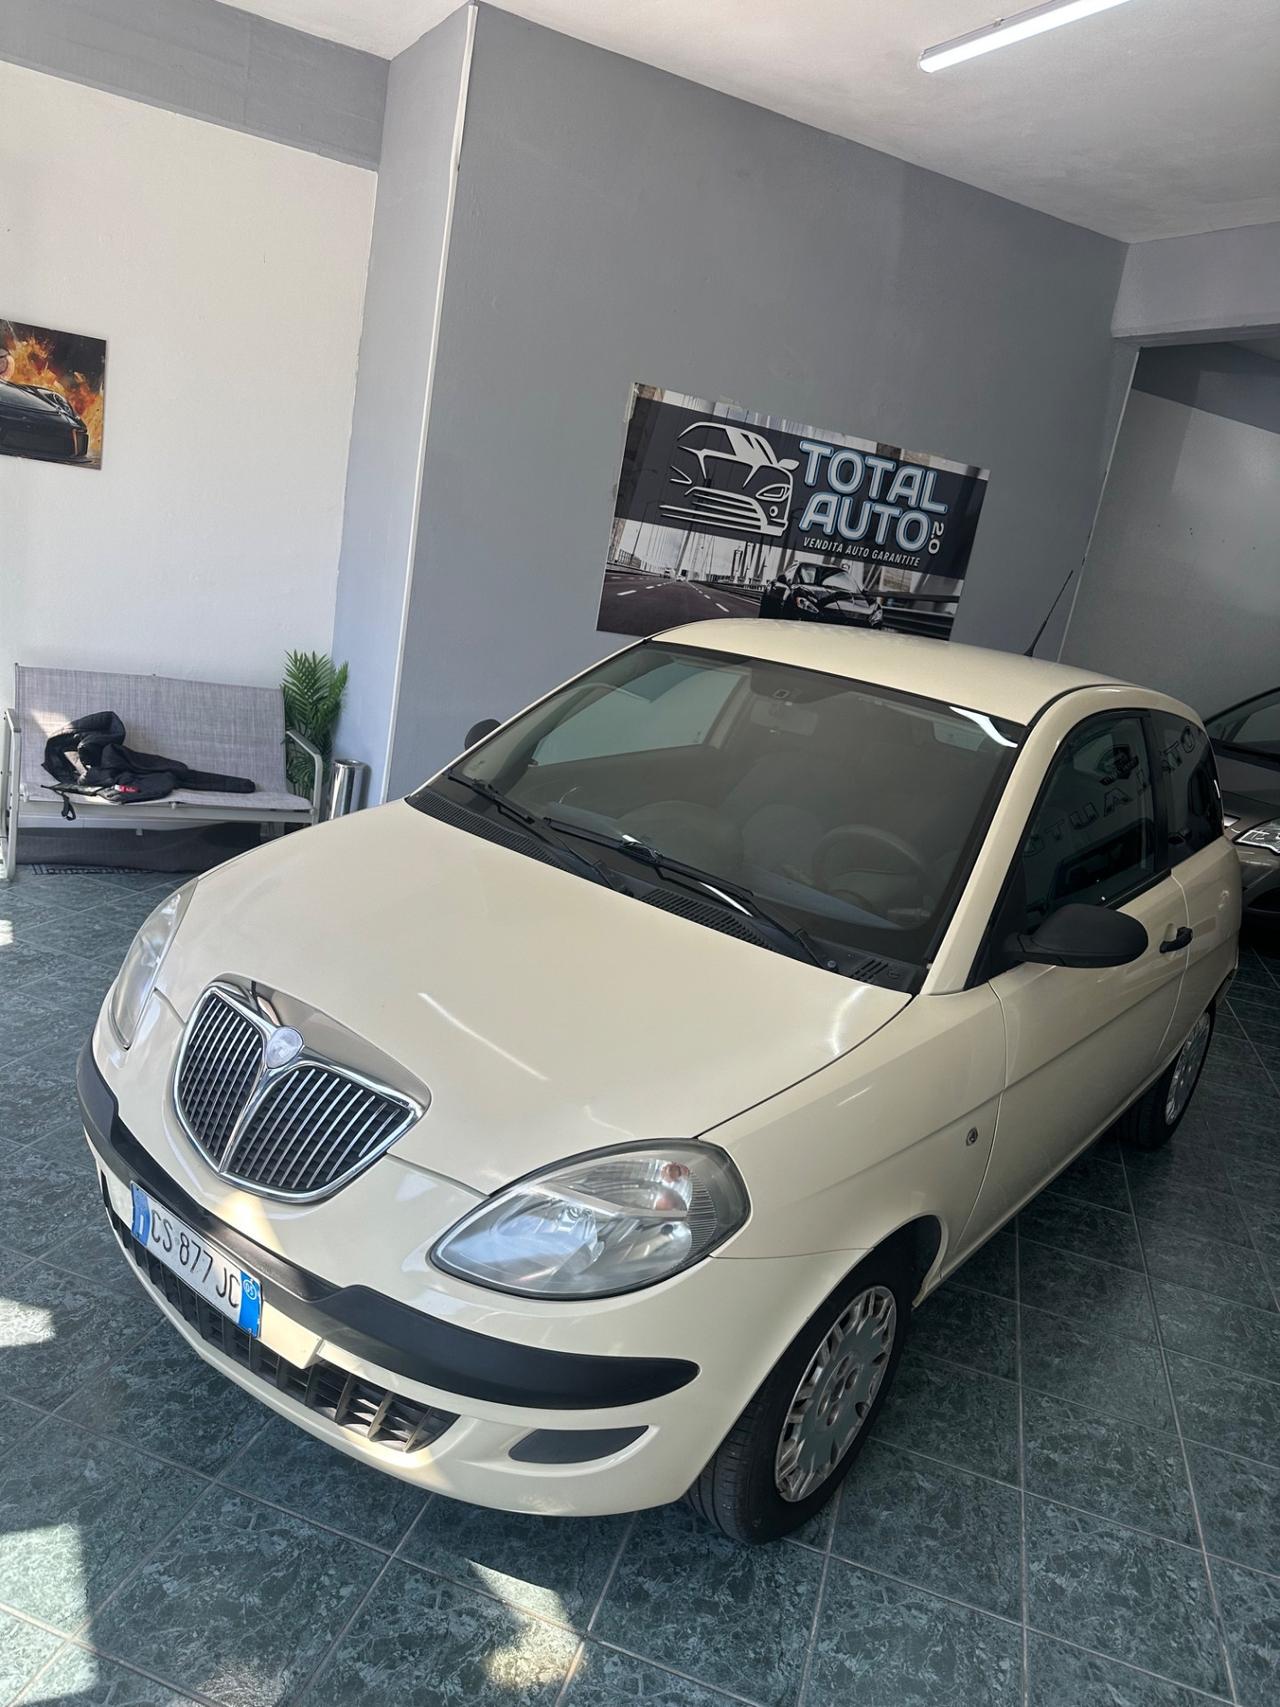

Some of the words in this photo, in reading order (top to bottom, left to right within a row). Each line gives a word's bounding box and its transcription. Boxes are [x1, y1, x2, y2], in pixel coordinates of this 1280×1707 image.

[799, 440, 948, 514] TOTAL
[798, 491, 931, 552] AUTO
[803, 537, 843, 553] VENDITA
[845, 545, 870, 557] AUTO
[871, 549, 921, 567] GARANTITE
[928, 521, 945, 555] 2.0
[151, 1209, 173, 1253] CS
[179, 1232, 214, 1283] 877
[215, 1268, 241, 1308] JC
